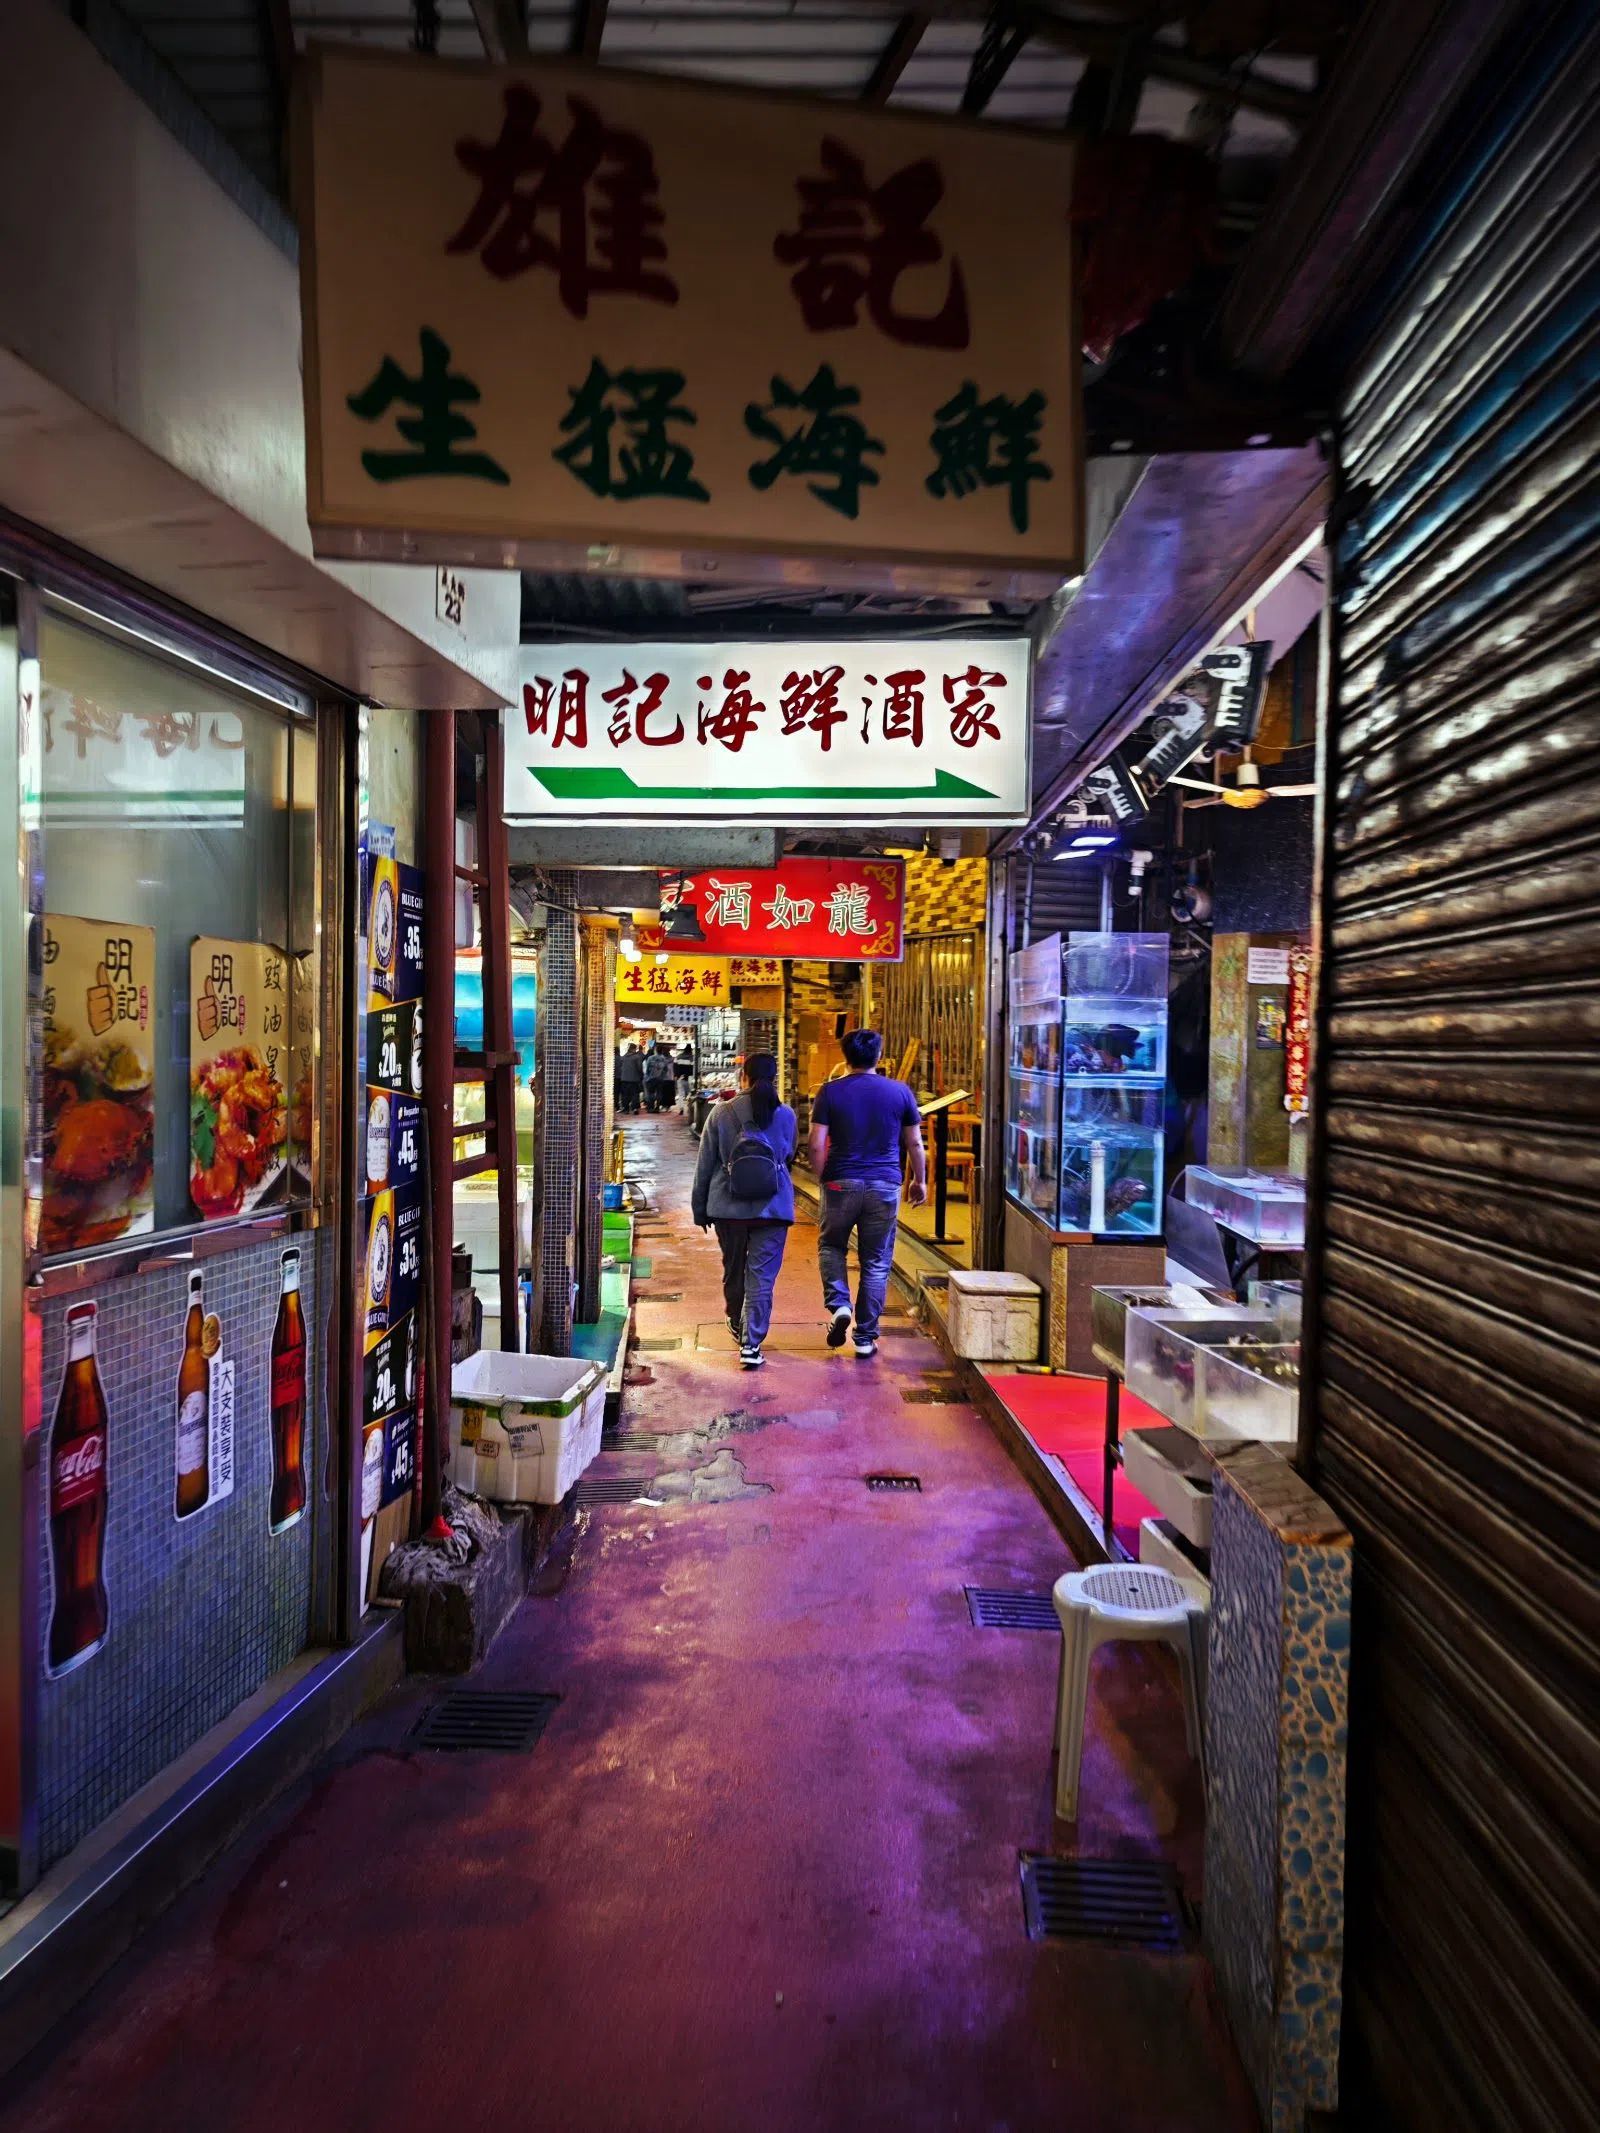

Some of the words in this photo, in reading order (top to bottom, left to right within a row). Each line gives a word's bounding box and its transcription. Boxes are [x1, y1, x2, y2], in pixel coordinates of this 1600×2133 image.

[444, 79, 971, 350] 雄記
[347, 327, 1053, 534] 生猛海鮮
[523, 665, 1007, 752] 明記海鮮酒家
[104, 938, 139, 1022] 明記
[211, 954, 238, 1027] 明記
[623, 965, 724, 996] 生猛海鮮
[221, 1367, 233, 1486] 大支裝享受
